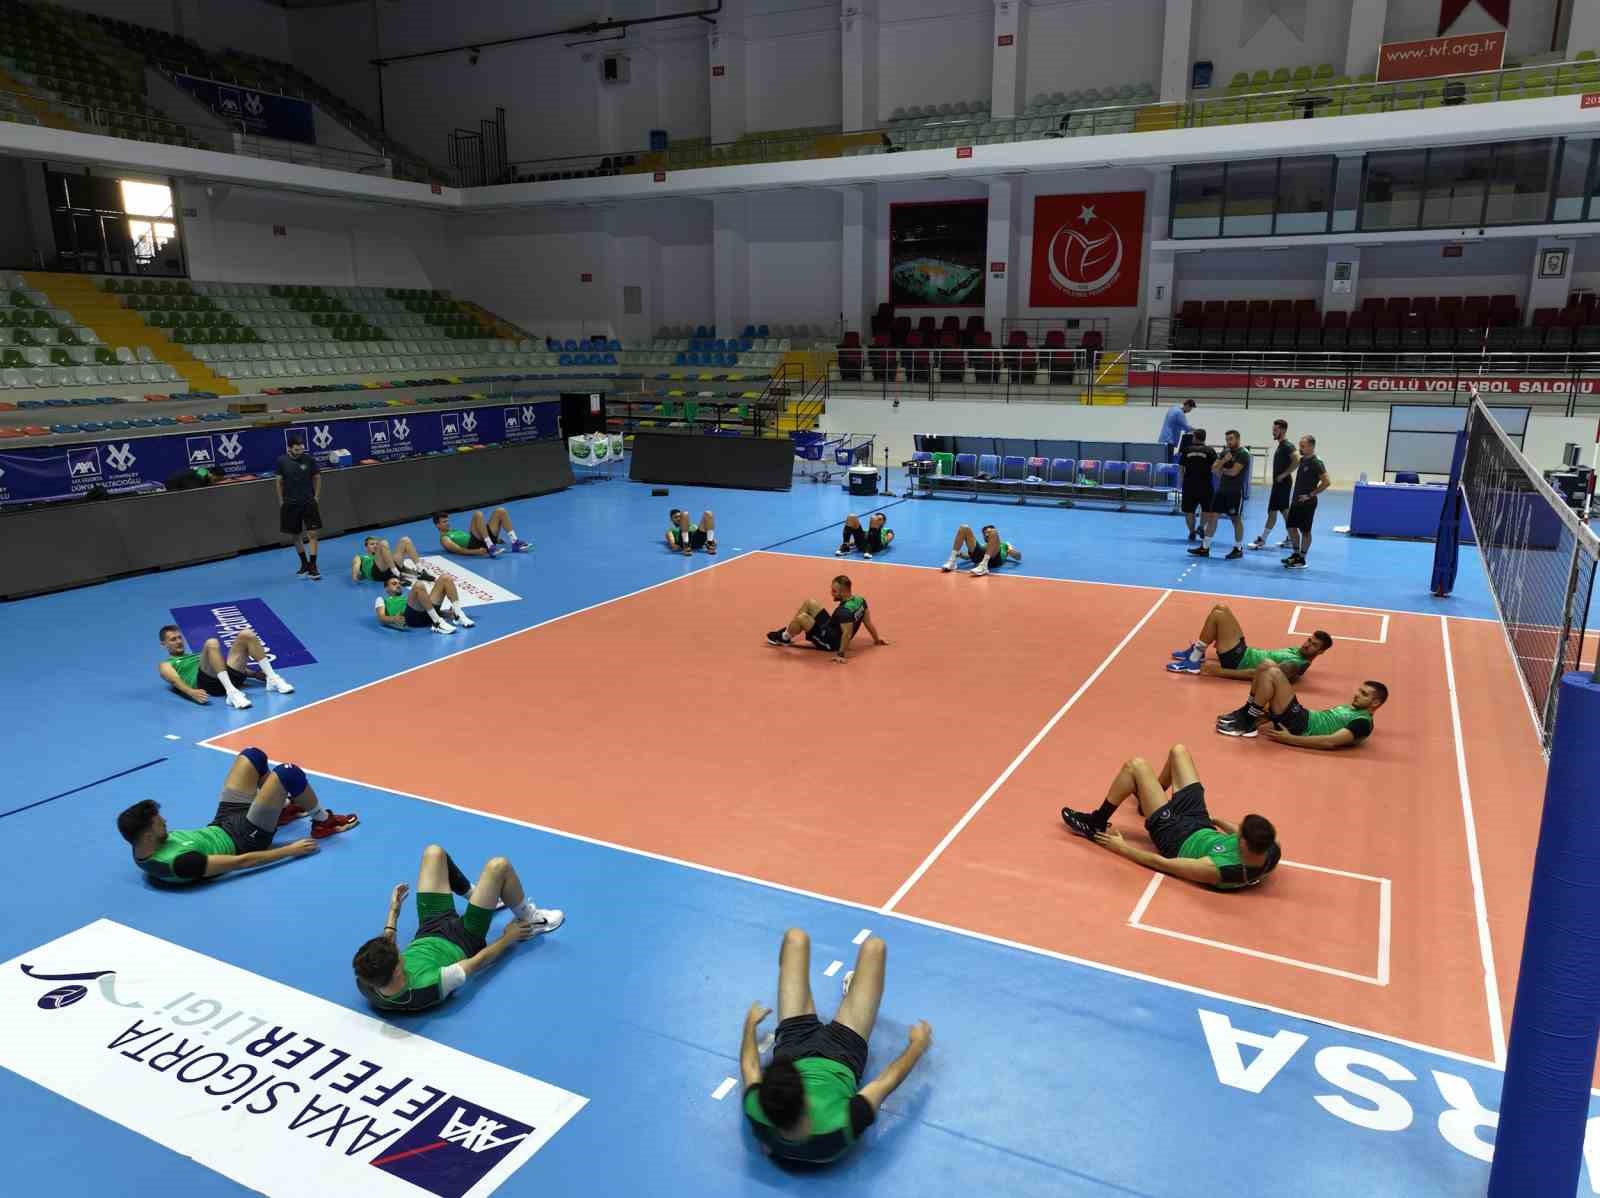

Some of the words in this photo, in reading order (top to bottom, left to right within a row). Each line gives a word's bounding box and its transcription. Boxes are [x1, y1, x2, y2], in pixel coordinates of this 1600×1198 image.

[1386, 39, 1497, 62] www.tvf.org.tr
[1272, 378, 1300, 388] TVF
[1367, 377, 1419, 391] GÖLLÜ
[72, 461, 97, 475] AXA
[107, 1019, 300, 1115] SİGORTA
[288, 1094, 402, 1156] AXA
[438, 1106, 530, 1153] AXA
